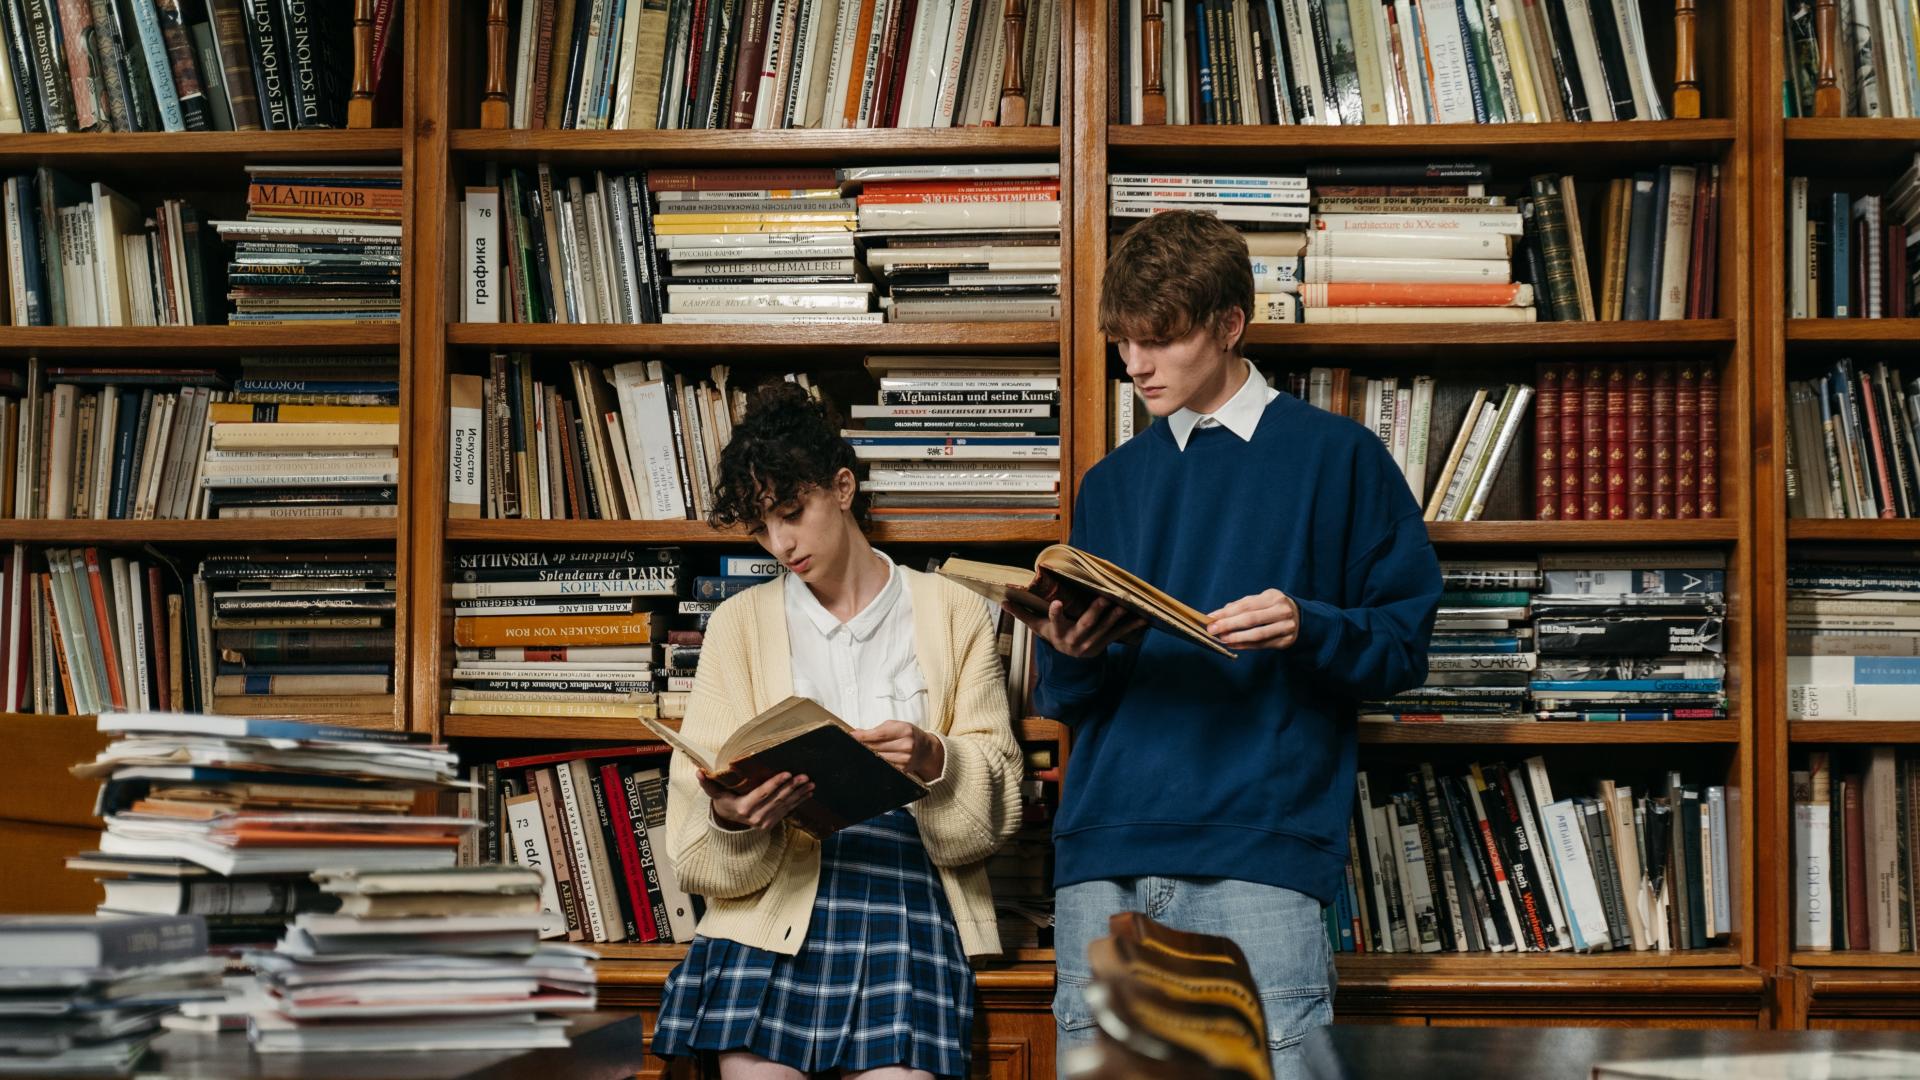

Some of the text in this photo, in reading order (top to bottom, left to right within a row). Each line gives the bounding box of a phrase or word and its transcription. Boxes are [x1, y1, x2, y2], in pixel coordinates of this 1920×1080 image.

[35, 22, 58, 108] ALTRUSSISCHE
[295, 27, 314, 90] SCHÖNE
[260, 36, 282, 97] SCHÖNE
[947, 56, 960, 80] UND
[155, 59, 172, 99] Eckardt
[741, 90, 752, 102] 17
[942, 82, 956, 117] ORDEN
[270, 100, 285, 123] DIE
[302, 94, 318, 118] DIE
[258, 185, 365, 208] М.АЛПАТОВ
[922, 196, 946, 204] SUR
[960, 195, 981, 203] PAS
[982, 195, 998, 203] DES
[1000, 193, 1051, 202] TEMPLIERS
[479, 208, 492, 218] 76
[828, 203, 851, 211] KUNST
[1344, 220, 1401, 230] L'architecture
[1403, 221, 1414, 229] du
[236, 265, 305, 274] PANKIEWICZ
[472, 237, 487, 304] графика
[1251, 262, 1268, 275] ds
[242, 381, 305, 391] РОКОТОВ
[898, 390, 1053, 404] Afghanistan und seine Kunst
[1380, 389, 1394, 420] HOME
[455, 429, 464, 482] Беларуси
[467, 428, 477, 486] Искусство
[269, 509, 343, 517] ВЕНЕЦИАНОВ
[460, 550, 635, 568] VERSAILLES de Splendeurs
[539, 566, 676, 581] Splendeurs de PARIS
[560, 580, 667, 593] KOPENHAGEN
[1682, 572, 1703, 591] A
[1795, 578, 1809, 586] der
[1810, 578, 1818, 586] in
[1819, 576, 1860, 587] Städtebau
[1862, 579, 1877, 587] und
[460, 598, 536, 607] DAS GEGENBILD
[558, 604, 628, 613] KARLA BILANG
[505, 625, 640, 637] DIE MOSAIKEN VON ROM
[1669, 627, 1694, 635] Pioniere
[1470, 654, 1529, 668] SCARPA
[489, 681, 612, 690] Merveilleux Châteaux de la Loire
[1810, 687, 1818, 717] EGYPT
[519, 705, 540, 714] LES
[546, 706, 561, 714] ET
[600, 706, 615, 714] LA
[560, 766, 580, 836] PLAKATKUNST
[592, 783, 609, 826] ILE-DE-FRANCE
[516, 819, 529, 828] 73
[624, 776, 661, 893] Les Rois de France
[575, 840, 591, 891] LEIPZIGER
[1514, 864, 1528, 888] Bach
[1596, 849, 1617, 928] ГРАЖДАНСКИЕ ЗДАНИЯ
[1808, 855, 1822, 924] МОСКВА
[587, 900, 601, 939] HORNIG
[1524, 891, 1546, 948] Wohnheime
[627, 921, 635, 935] SUN
